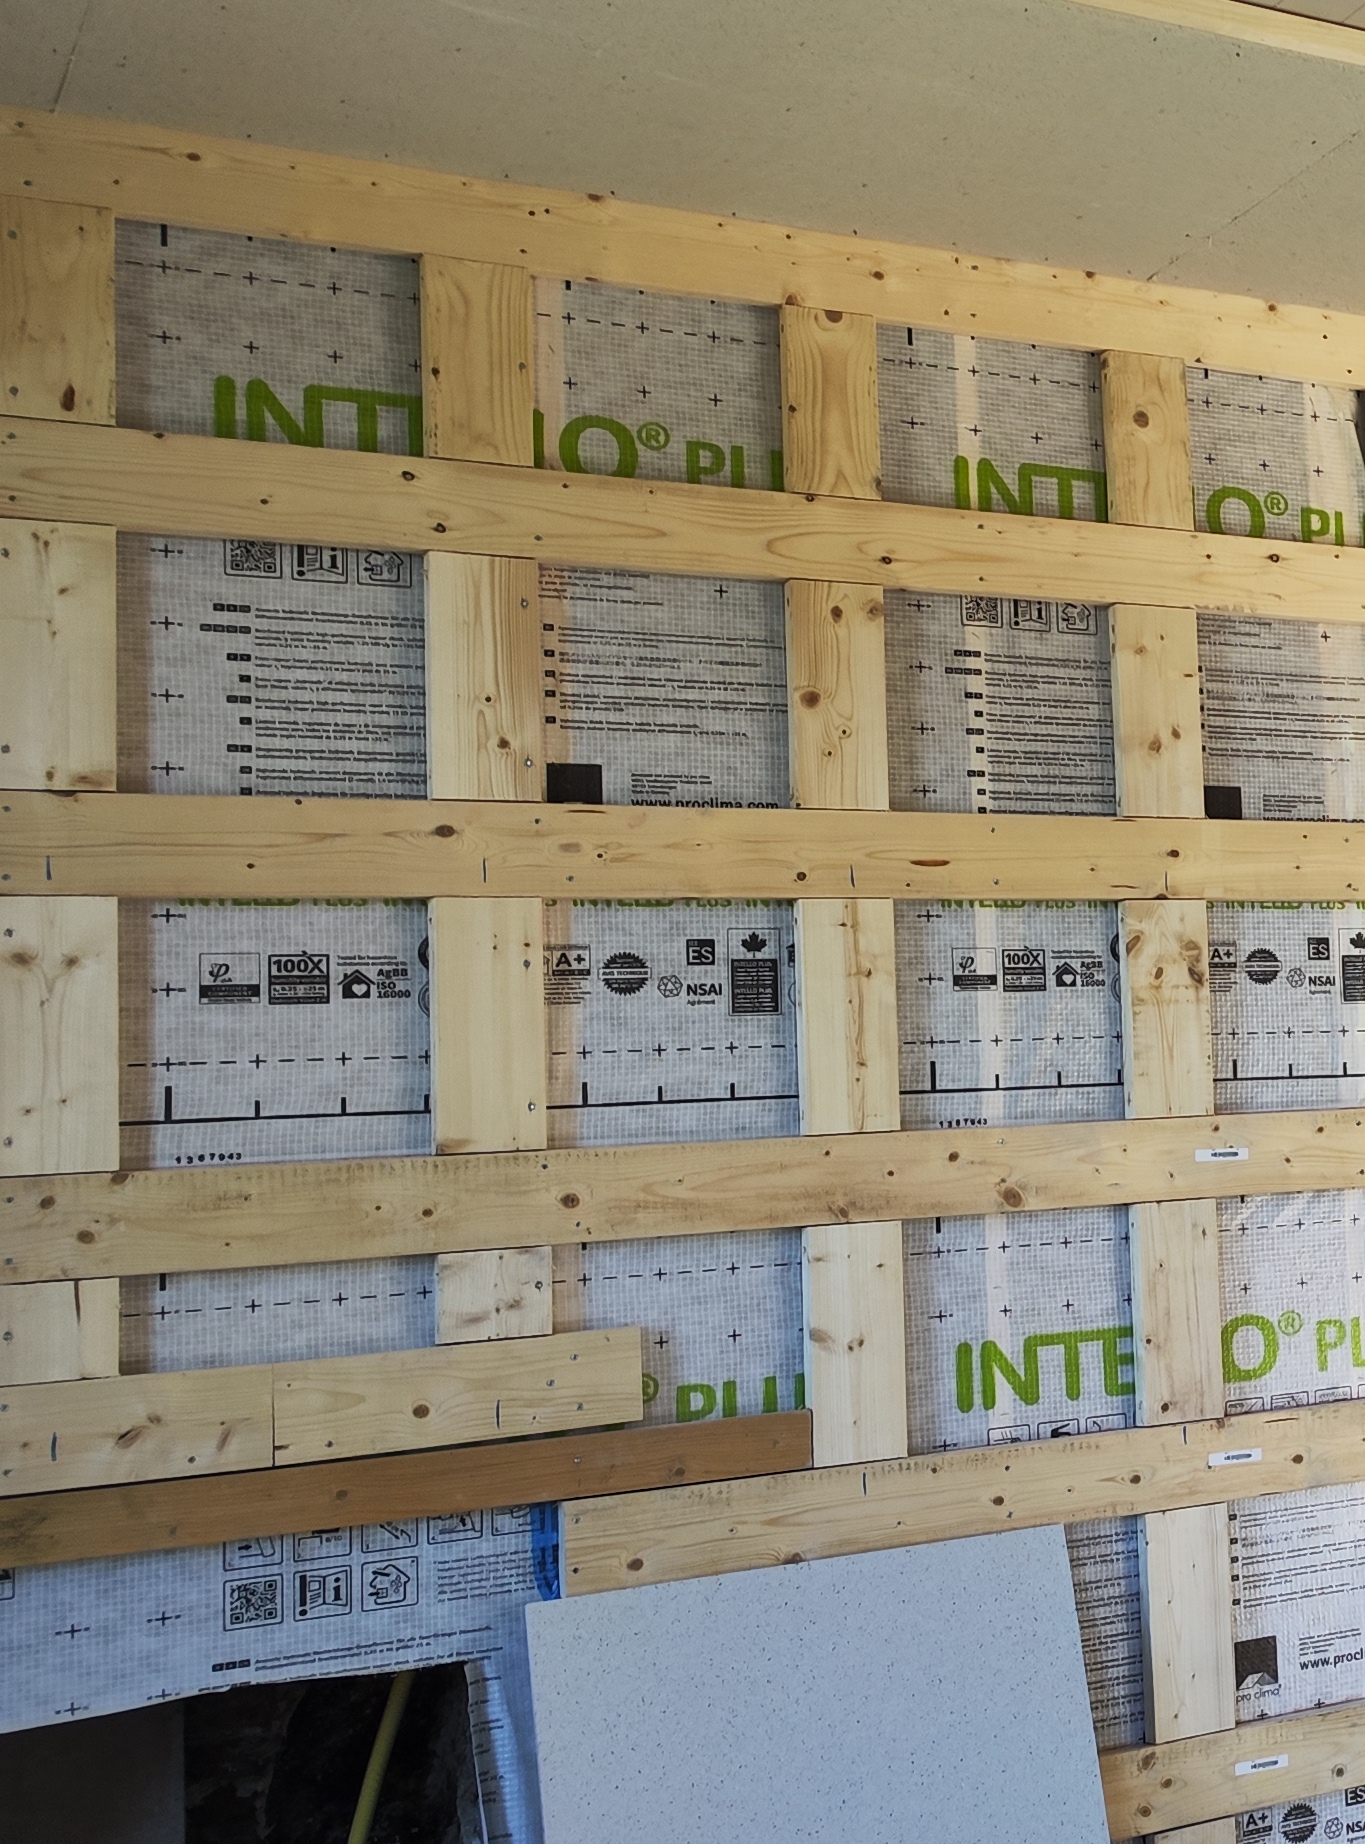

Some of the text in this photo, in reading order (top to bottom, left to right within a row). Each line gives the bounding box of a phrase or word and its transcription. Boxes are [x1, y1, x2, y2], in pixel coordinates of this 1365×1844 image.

[688, 947, 713, 964] ES
[1210, 948, 1233, 961] A+
[1309, 944, 1328, 958] ES
[555, 953, 586, 968] A+
[1005, 952, 1042, 966] 100X
[272, 958, 325, 975] 100X
[376, 981, 396, 990] ISO
[1308, 975, 1336, 987] NSAI
[376, 989, 411, 999] 16000
[686, 983, 723, 997] NSAI
[1346, 1787, 1365, 1803] ES
[1246, 1812, 1269, 1829] A+
